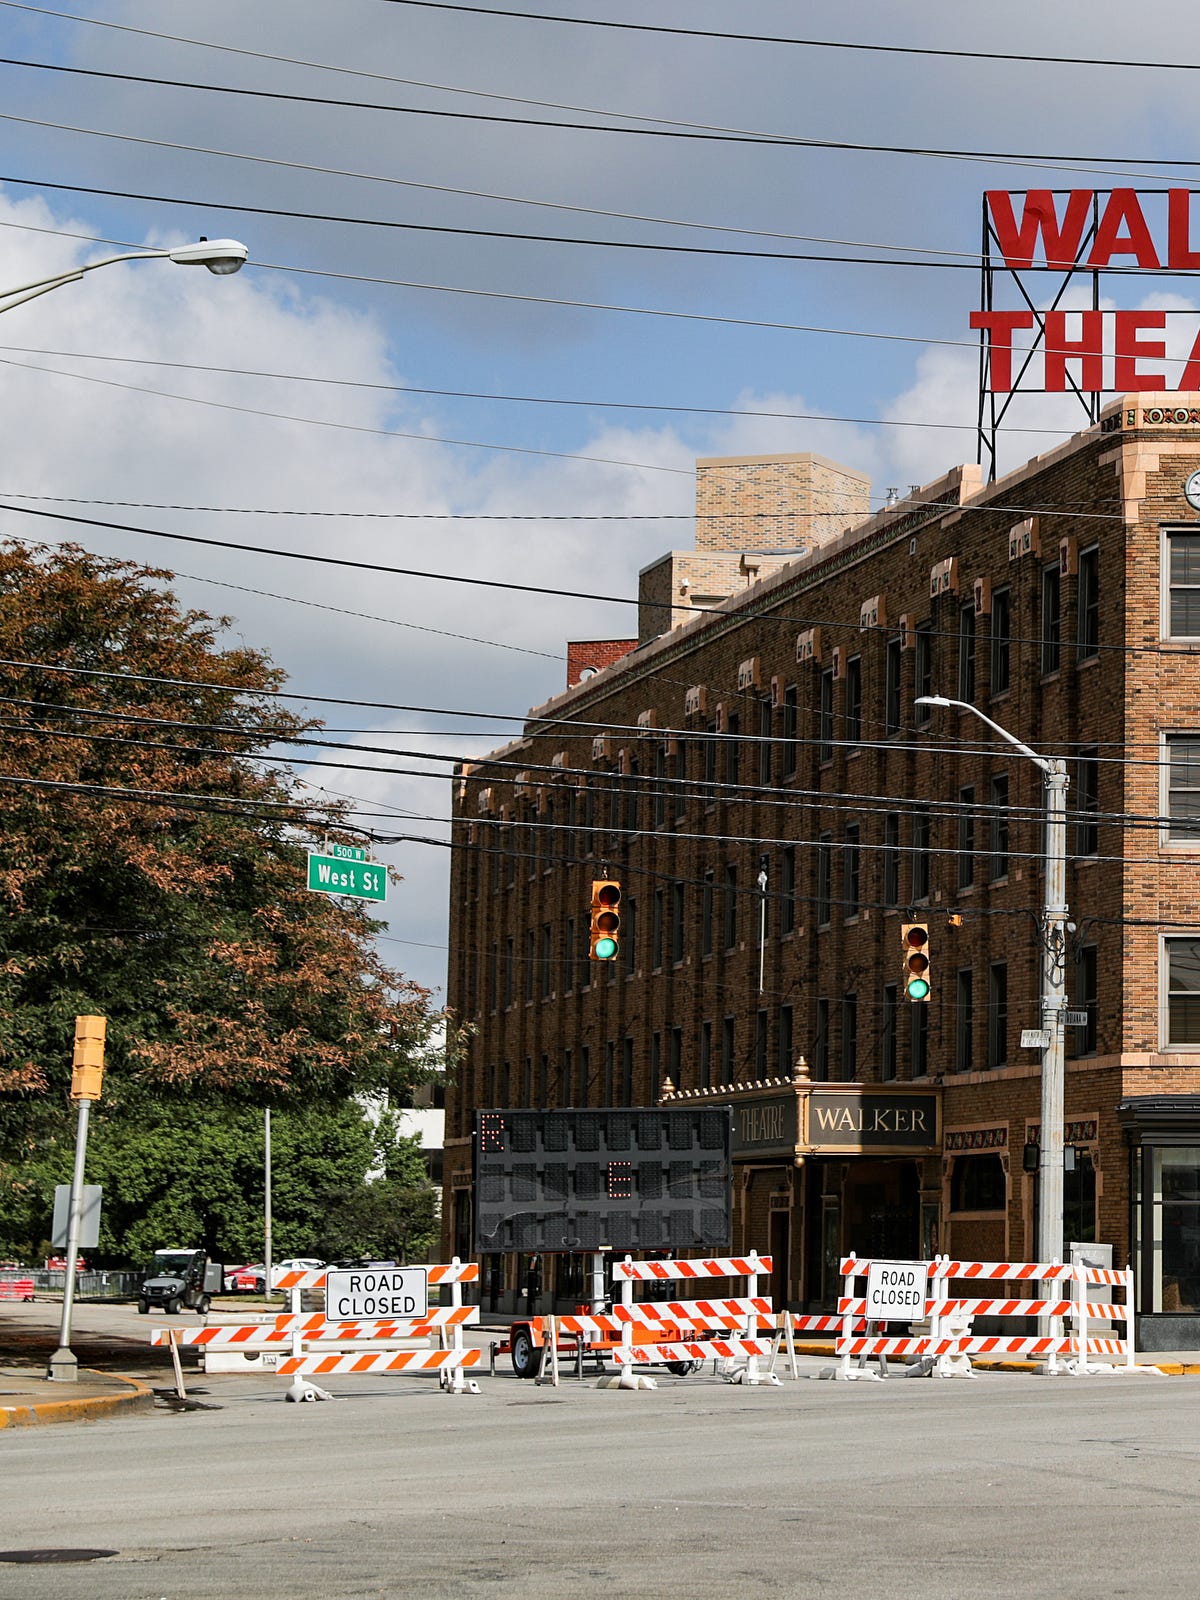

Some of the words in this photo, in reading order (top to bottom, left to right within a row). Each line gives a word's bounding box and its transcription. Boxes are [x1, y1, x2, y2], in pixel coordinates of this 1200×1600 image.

[336, 846, 353, 859] 500
[355, 849, 362, 860] W
[318, 863, 356, 889] West
[362, 872, 379, 892] St
[740, 1104, 785, 1142] THEATRE
[814, 1106, 928, 1132] WALKER
[481, 1114, 505, 1151] R
[608, 1161, 632, 1198] E
[350, 1274, 404, 1293] ROAD
[881, 1270, 915, 1286] ROAD
[338, 1296, 416, 1316] CLOSED
[872, 1289, 921, 1306] CLOSED
